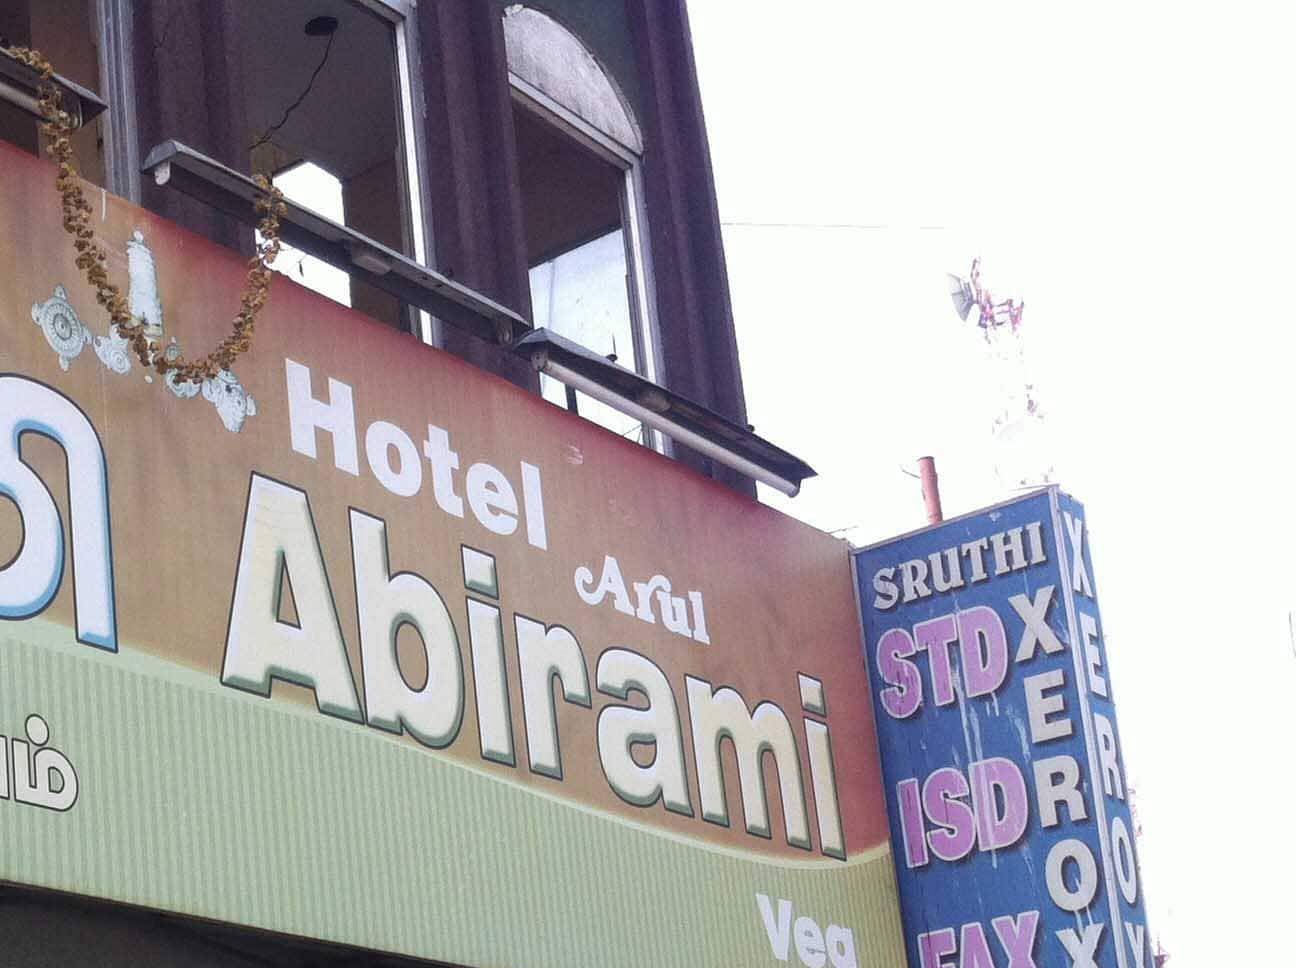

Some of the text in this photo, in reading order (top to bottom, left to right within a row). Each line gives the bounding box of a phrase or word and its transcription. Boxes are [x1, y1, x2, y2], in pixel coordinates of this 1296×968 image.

[285, 357, 549, 550] Hotel
[574, 555, 711, 645] Arul
[872, 521, 1047, 611] SRUTHI
[220, 470, 848, 862] Abirami
[876, 606, 1009, 720] STD
[896, 757, 1030, 869] ISD
